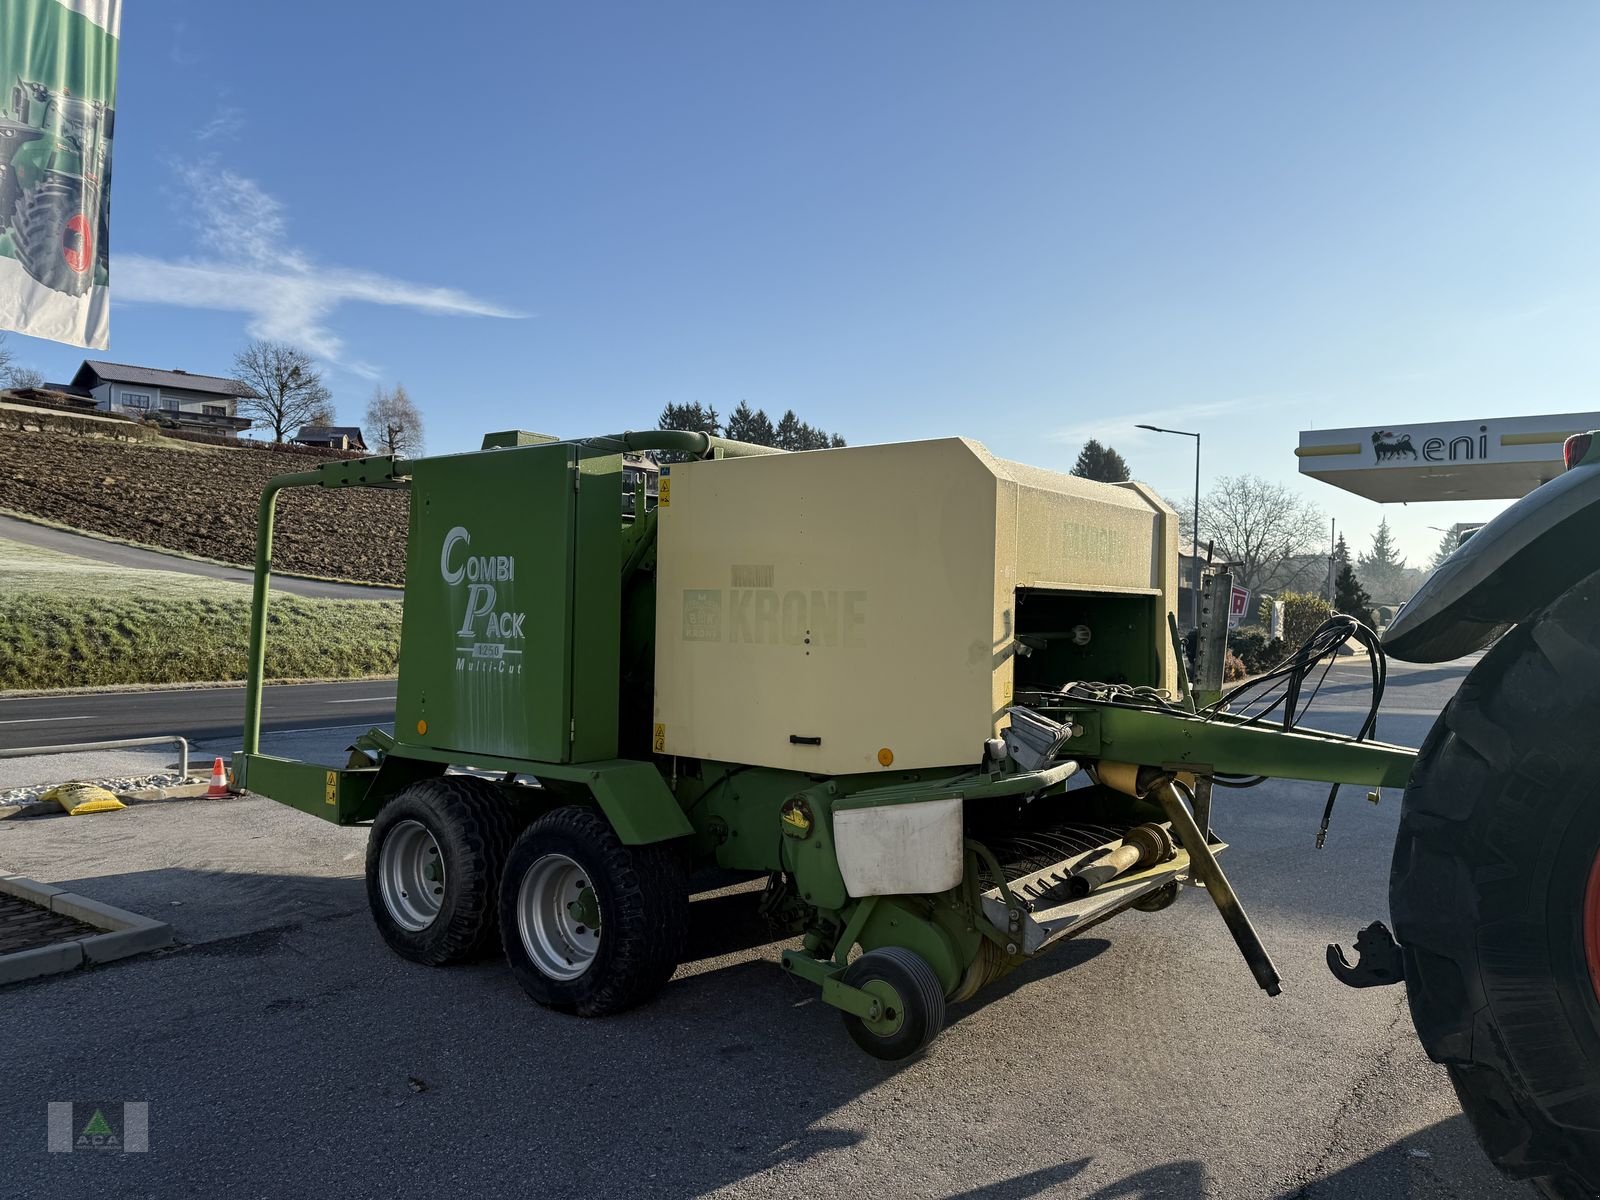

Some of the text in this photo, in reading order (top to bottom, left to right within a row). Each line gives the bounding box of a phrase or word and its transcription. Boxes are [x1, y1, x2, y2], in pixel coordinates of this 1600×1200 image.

[1422, 425, 1488, 463] eni
[440, 526, 515, 586] COMBI
[456, 583, 526, 639] PACK
[729, 589, 868, 648] KRONE
[455, 658, 522, 674] Multi-Cut
[477, 644, 500, 657] 1250
